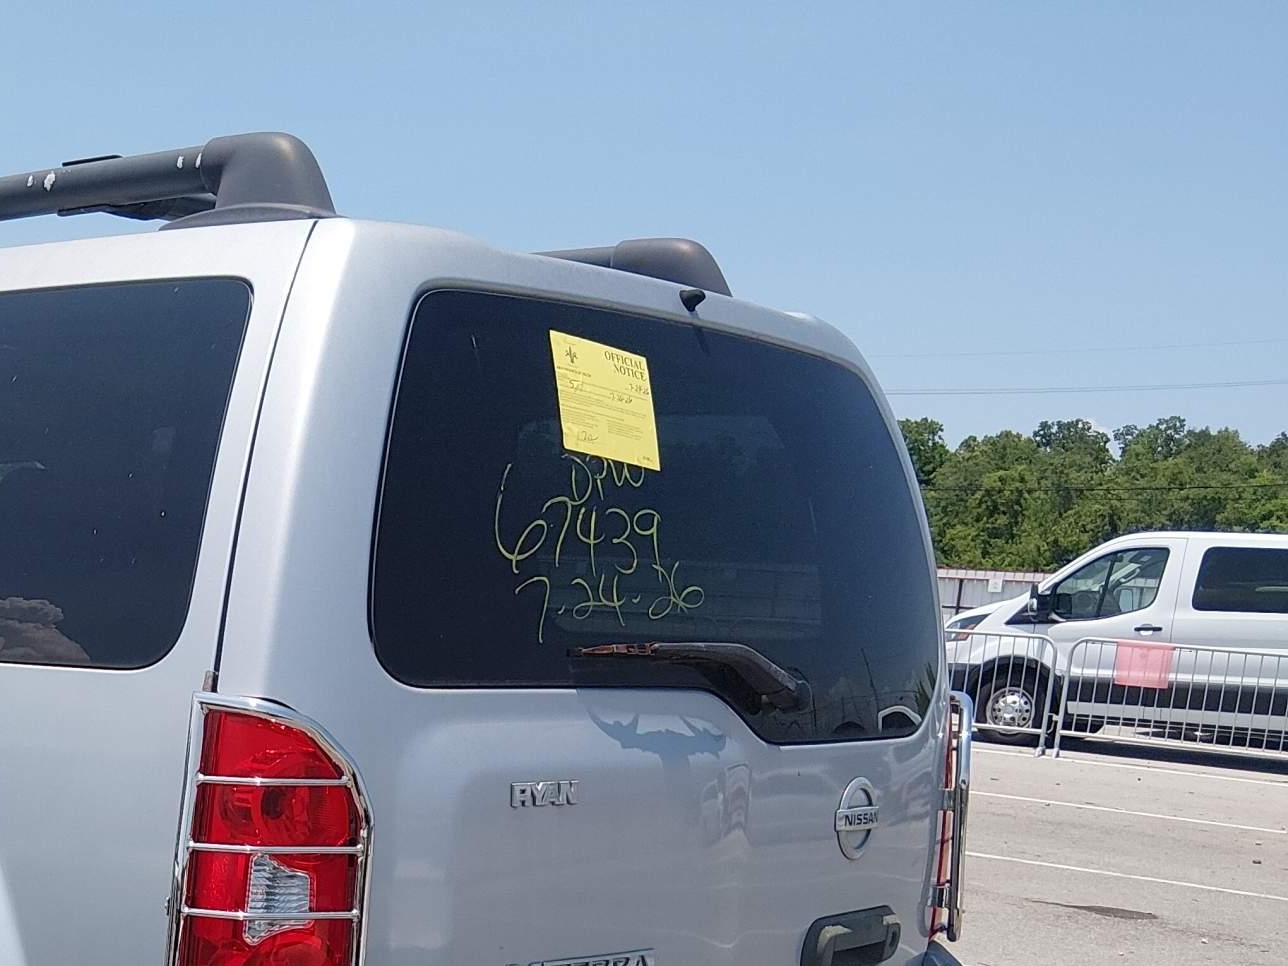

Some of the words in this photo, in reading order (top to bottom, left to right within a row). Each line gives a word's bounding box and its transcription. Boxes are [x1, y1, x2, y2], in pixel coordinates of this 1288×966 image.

[604, 350, 645, 371] OFFICIAL
[613, 363, 648, 382] NOTICE
[494, 463, 662, 582] 67439
[510, 780, 579, 808] RYAN
[844, 811, 878, 827] NISSAN
